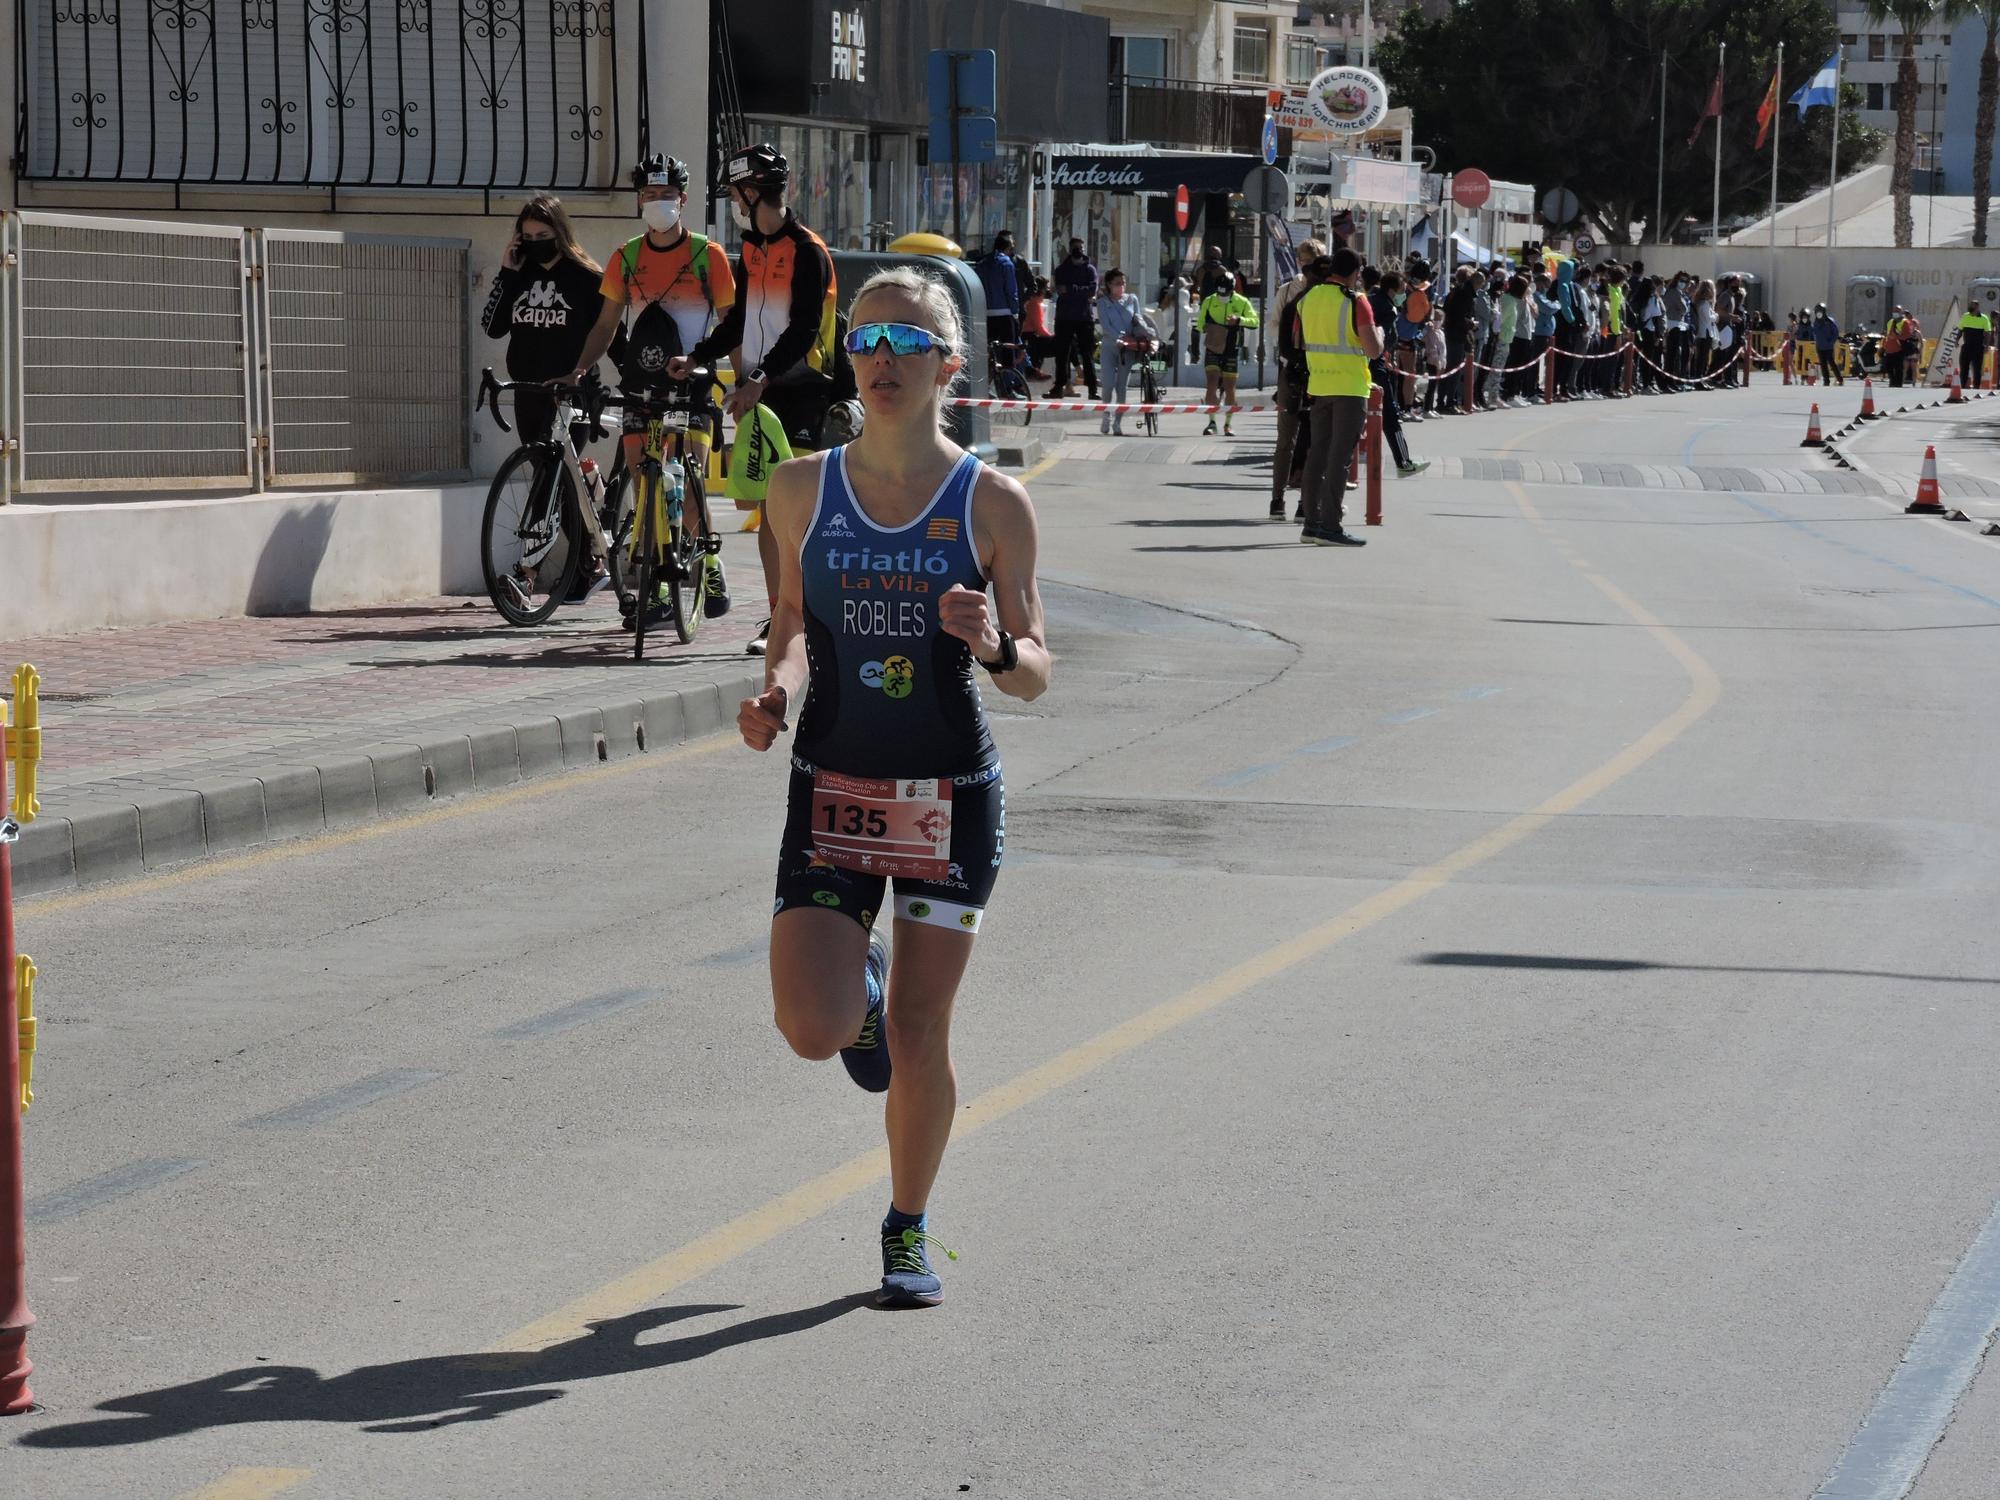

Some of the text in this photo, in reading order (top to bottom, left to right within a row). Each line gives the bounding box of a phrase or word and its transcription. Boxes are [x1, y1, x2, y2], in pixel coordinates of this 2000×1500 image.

[1316, 72, 1379, 93] HELADERIA
[1310, 103, 1381, 129] HORCHATERIA
[1577, 240, 1590, 249] 30
[511, 305, 567, 328] Kappa
[745, 451, 760, 482] NIKE
[826, 548, 949, 575] triatló
[841, 573, 929, 593] La Vila
[843, 599, 926, 638] ROBLES
[822, 804, 888, 838] 135
